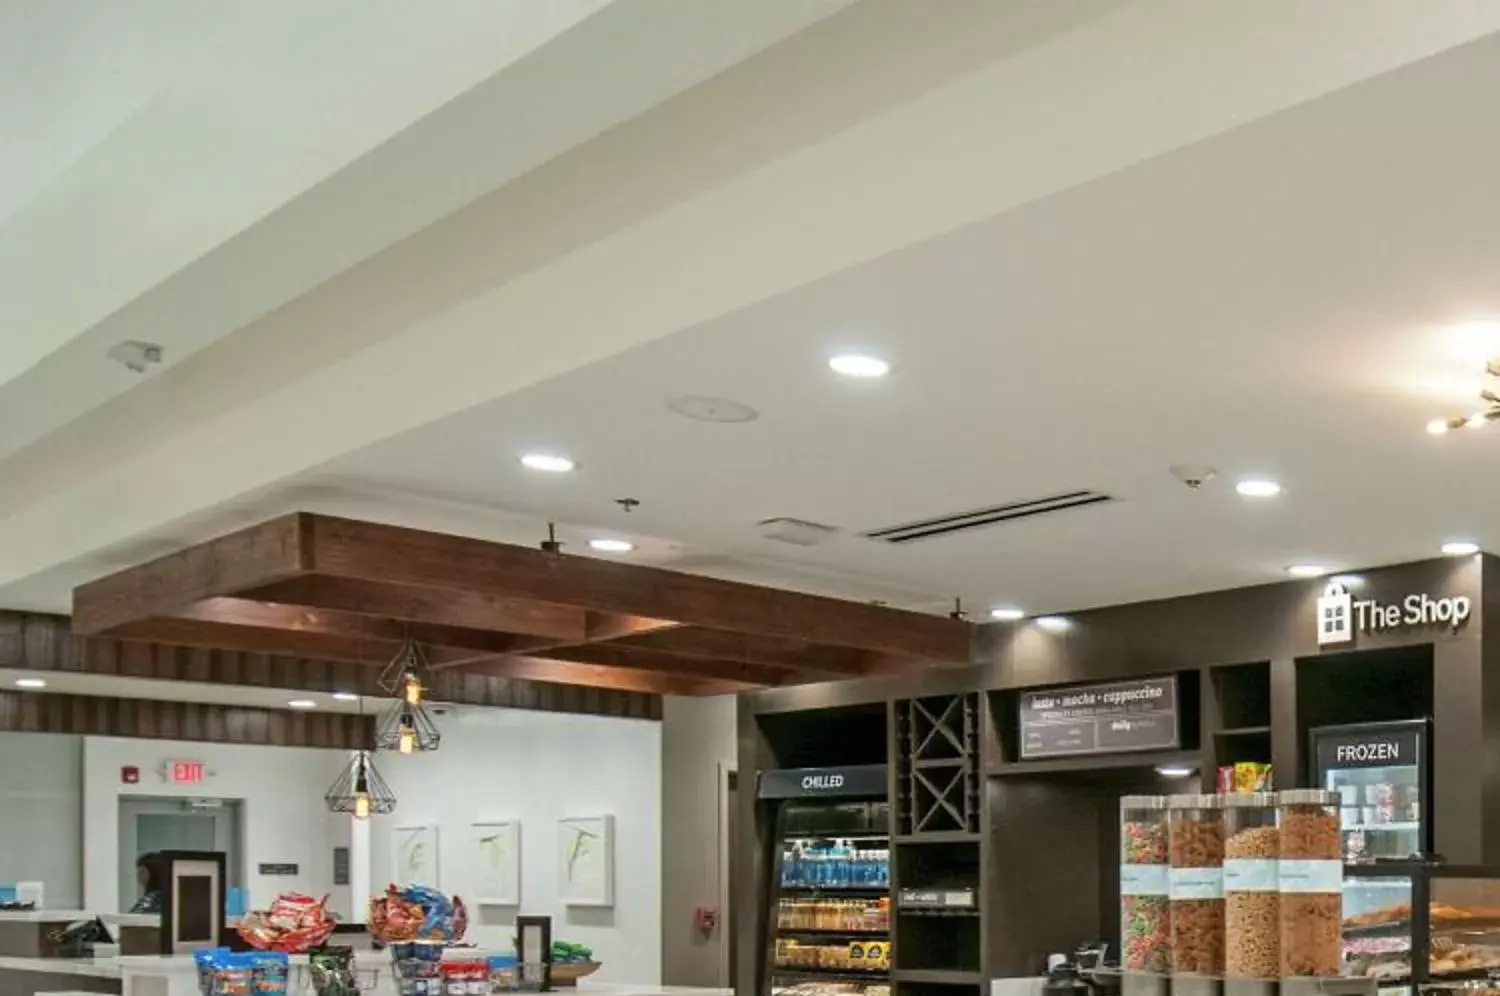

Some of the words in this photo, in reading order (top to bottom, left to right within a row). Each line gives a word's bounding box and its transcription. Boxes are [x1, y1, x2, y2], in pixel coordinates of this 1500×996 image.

[1353, 599, 1400, 631] The
[1403, 592, 1470, 627] Shop
[1103, 685, 1163, 705] cappuccino
[1336, 742, 1399, 761] FROZEN
[174, 763, 204, 781] EXIT
[801, 775, 844, 789] CHILLED
